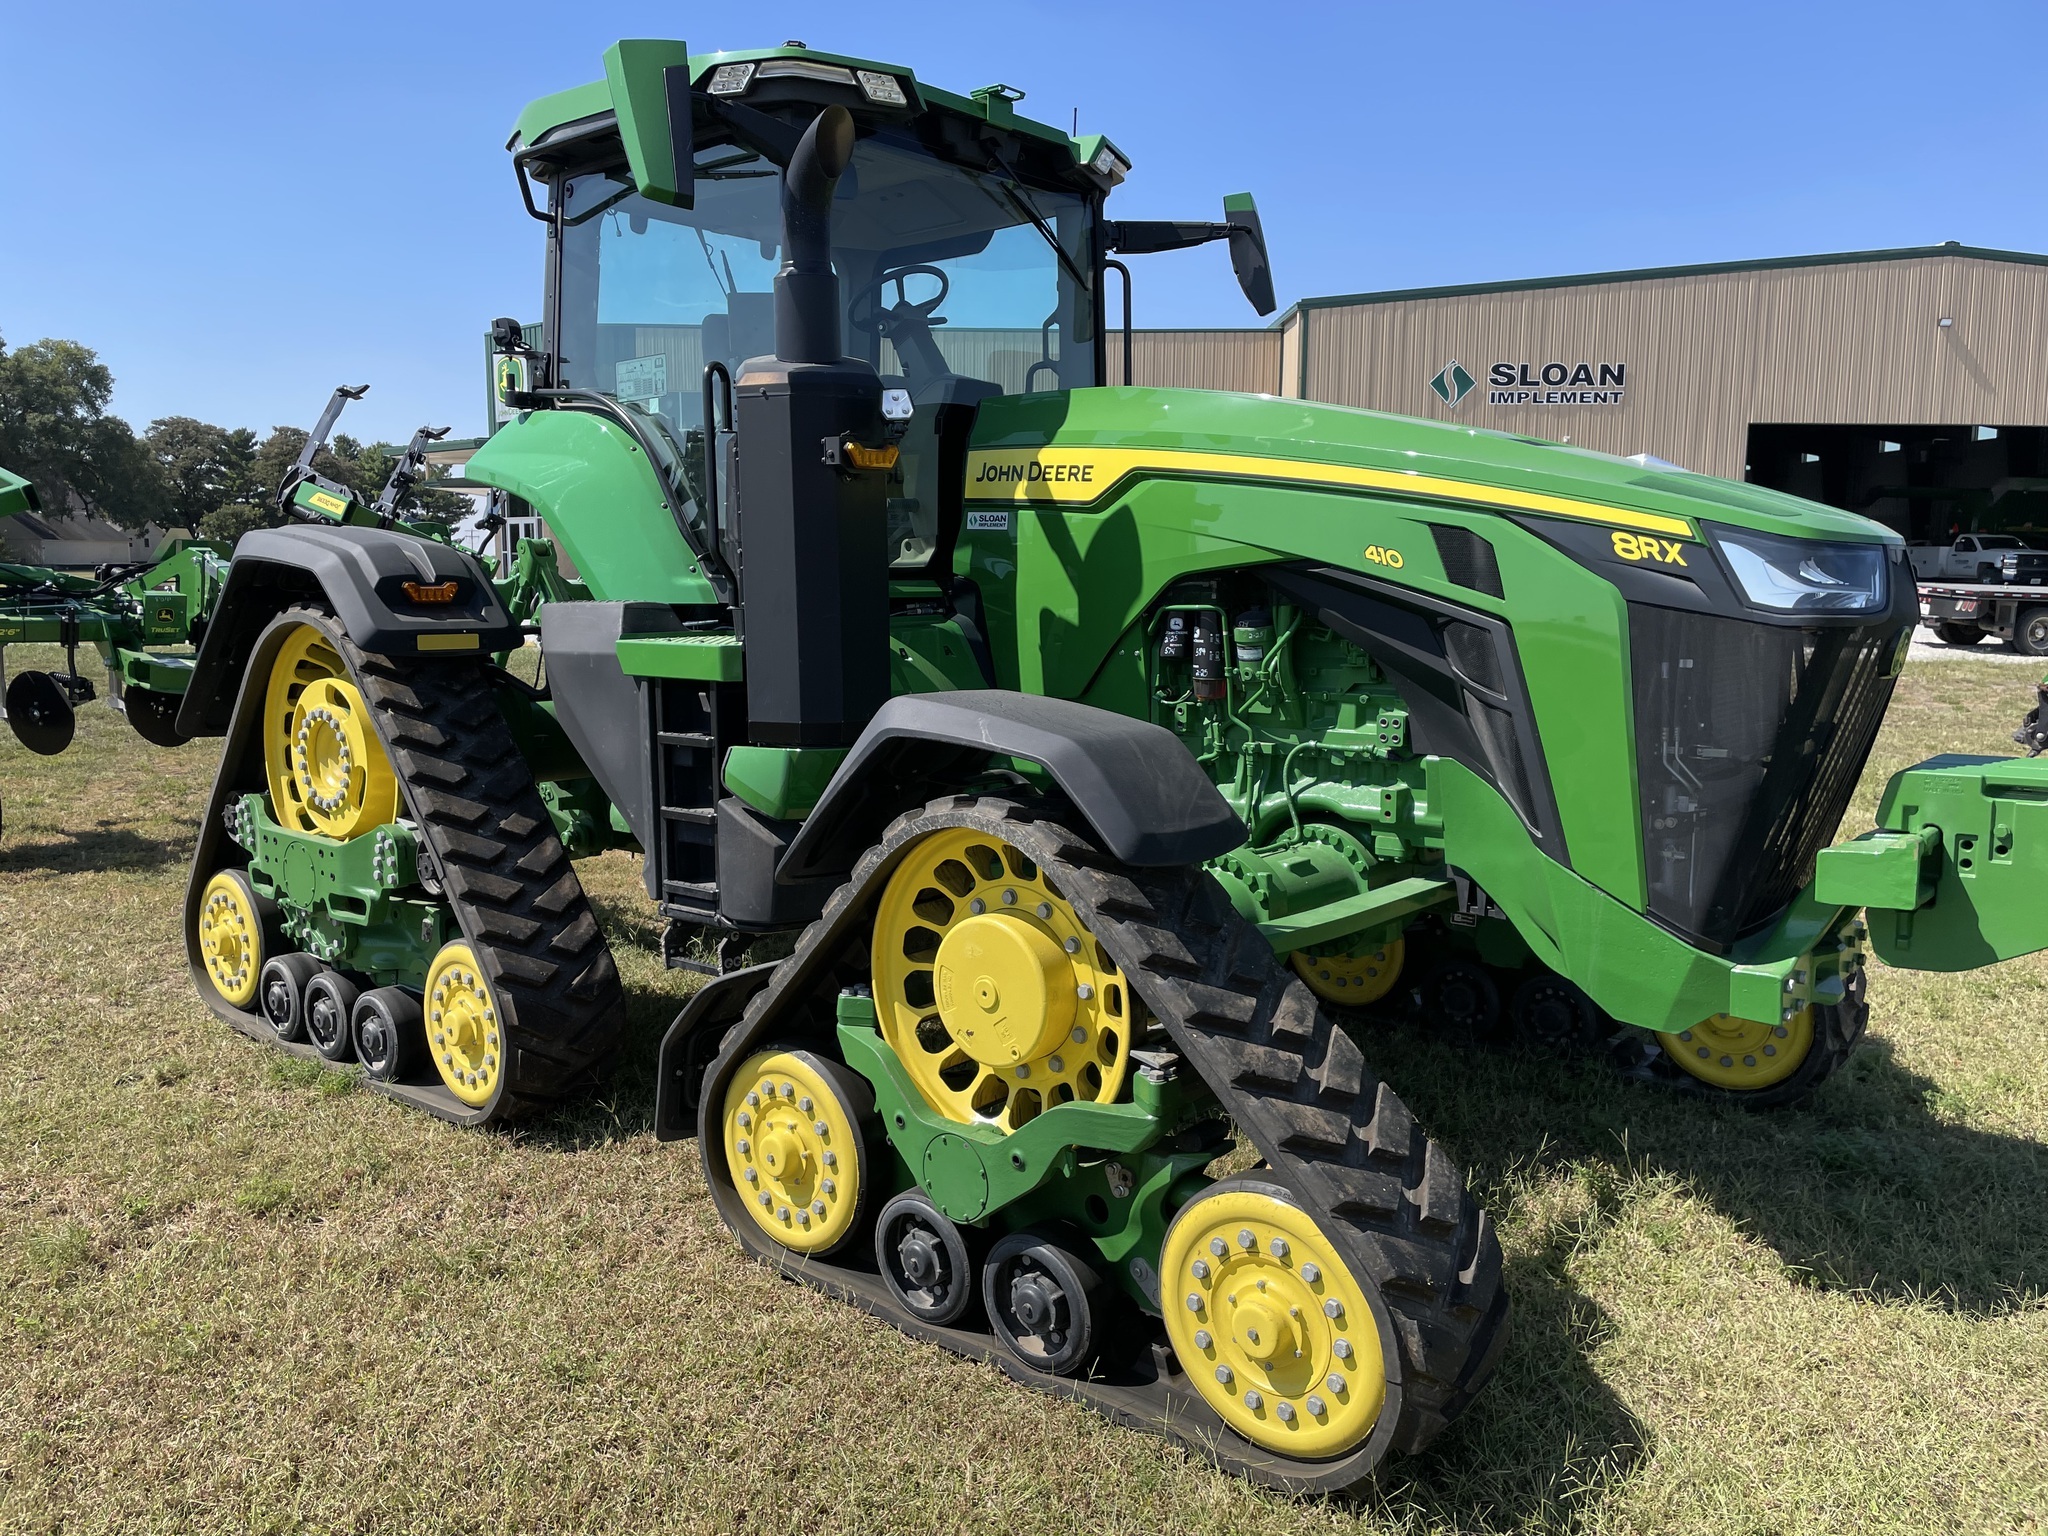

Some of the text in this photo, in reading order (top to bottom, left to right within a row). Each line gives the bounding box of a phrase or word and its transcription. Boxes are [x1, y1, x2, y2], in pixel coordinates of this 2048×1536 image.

[1488, 362, 1626, 387] SLOAN
[1488, 391, 1625, 405] IMPLEMENT
[976, 461, 1094, 482] JOHN DEERE
[978, 514, 1007, 523] SLOAN
[1364, 544, 1404, 569] 410
[1611, 531, 1688, 567] 8RX
